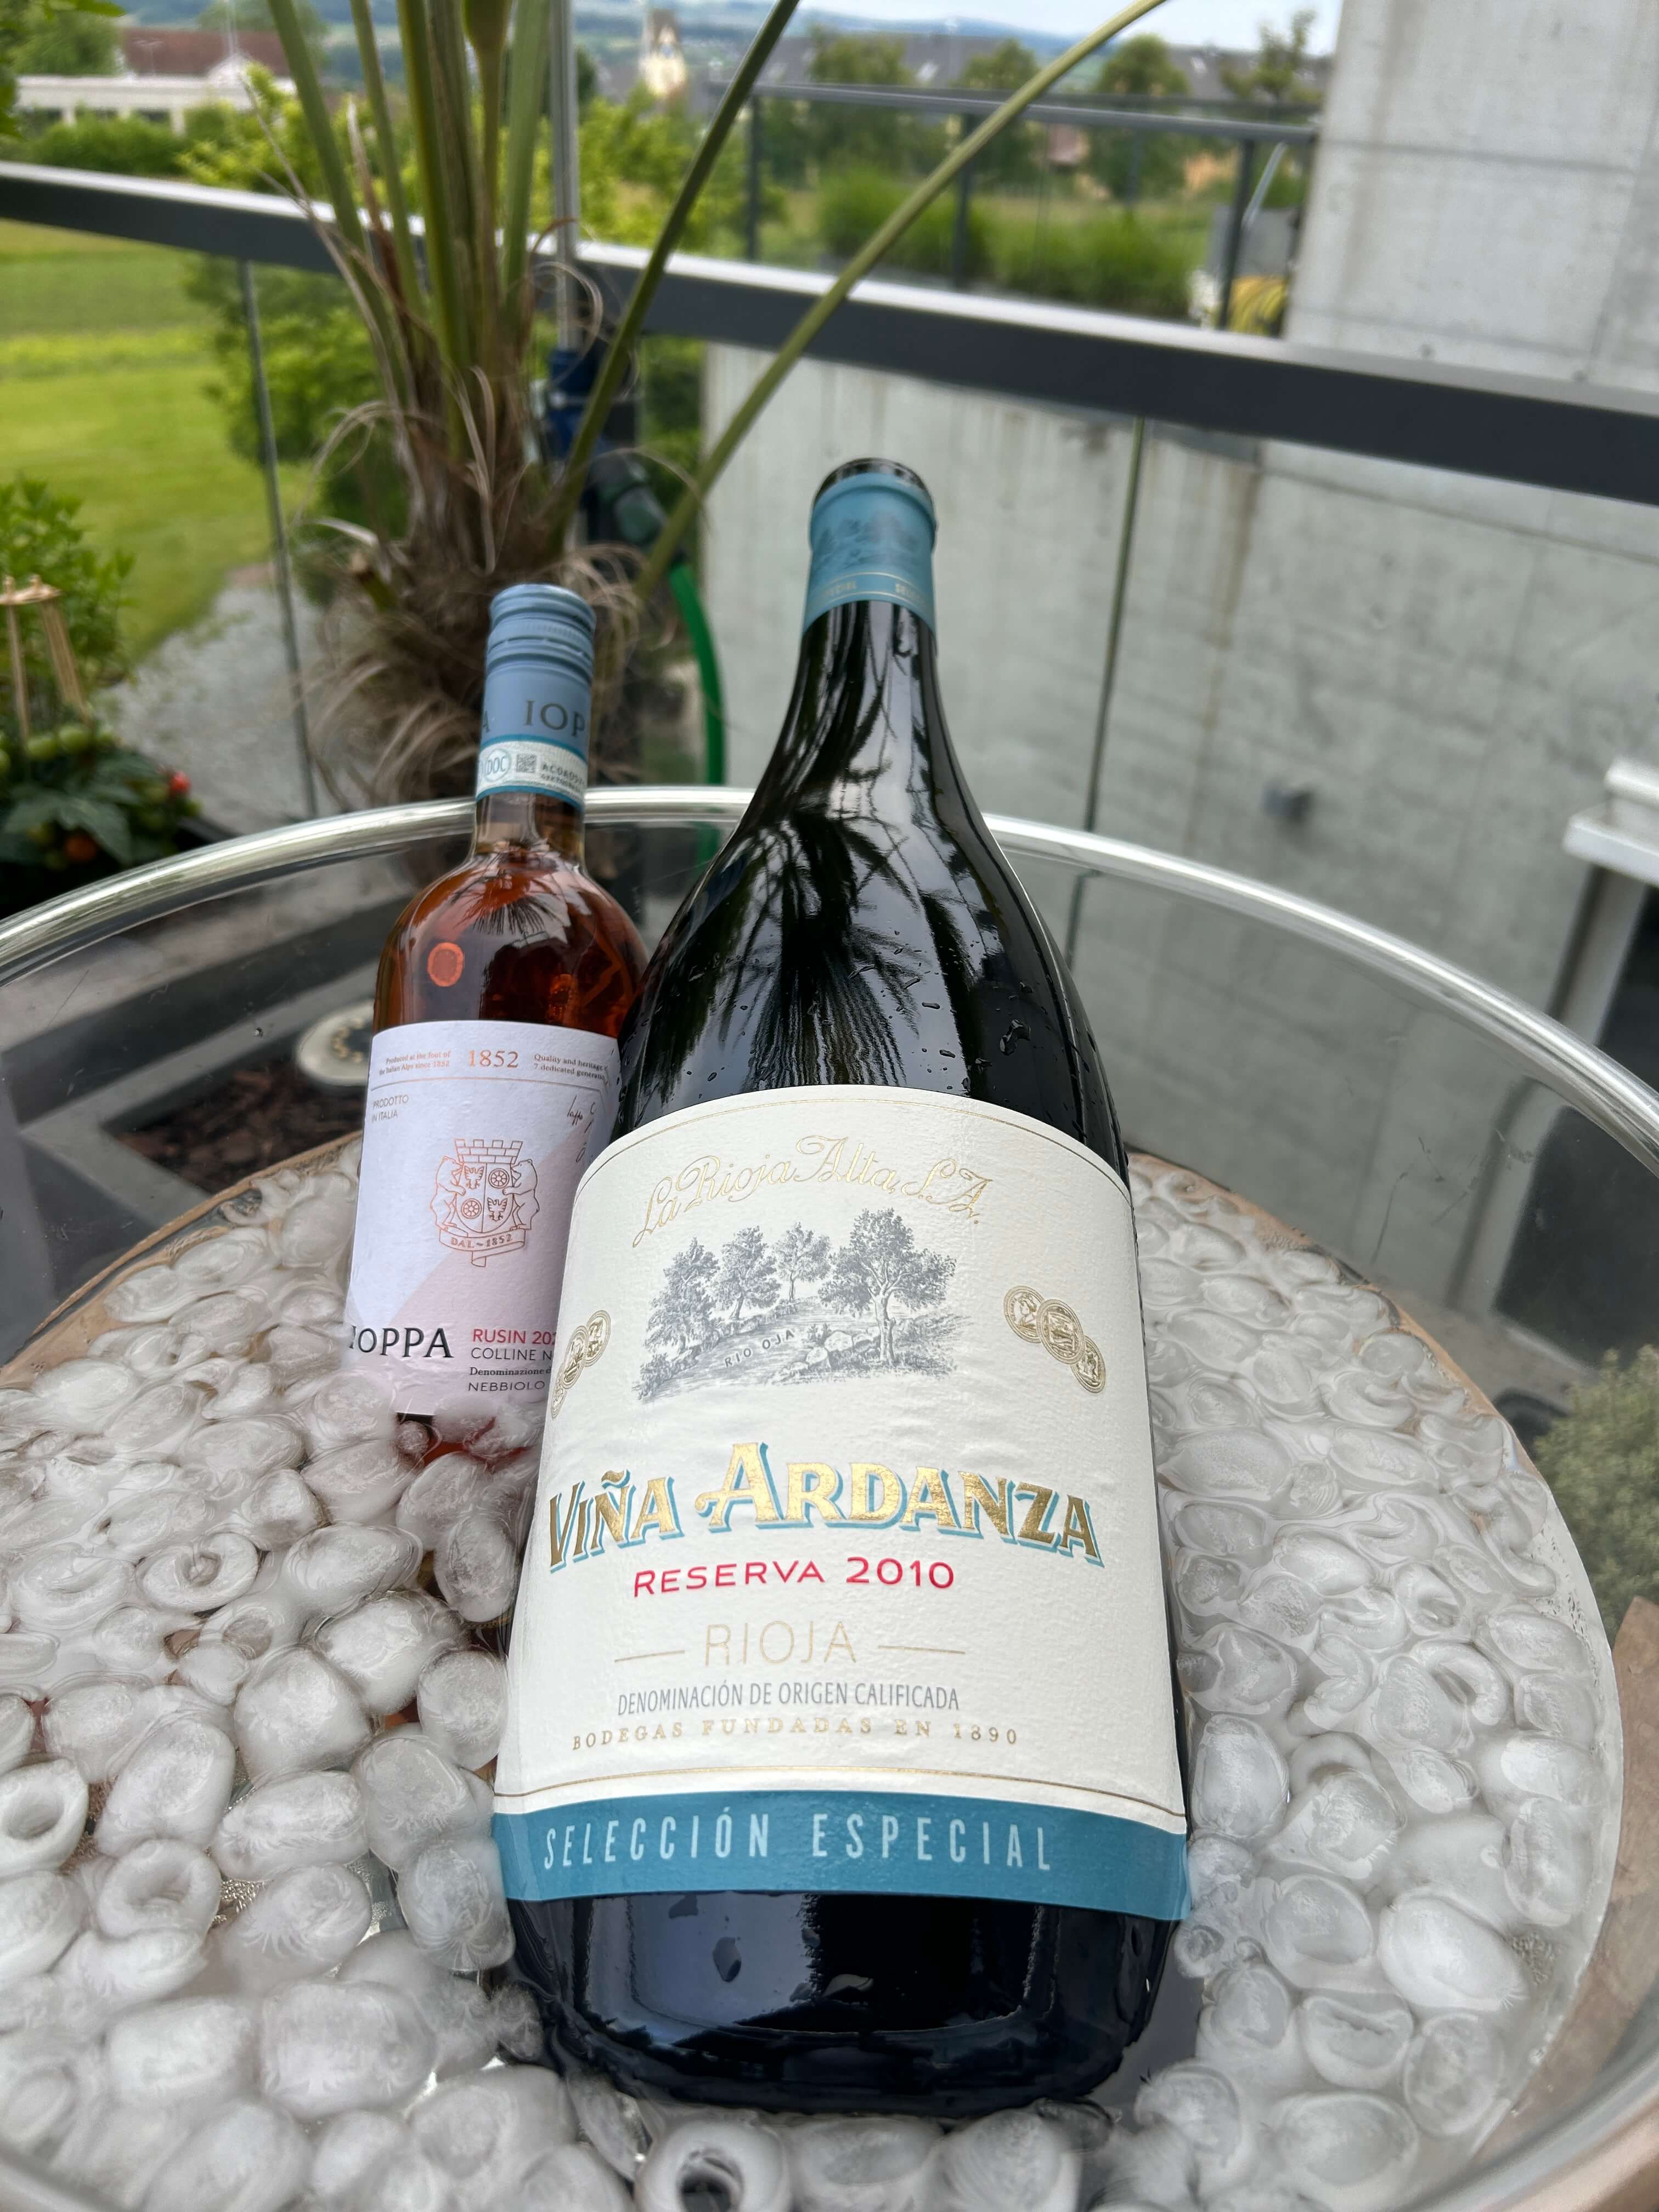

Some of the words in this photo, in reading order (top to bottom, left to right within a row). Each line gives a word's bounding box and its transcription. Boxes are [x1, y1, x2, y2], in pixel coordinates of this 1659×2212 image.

[487, 756, 507, 776] DOC
[386, 1054, 408, 1064] Produced
[443, 1049, 452, 1058] of
[468, 1049, 519, 1069] 1852
[534, 1053, 561, 1064] Quality
[578, 1059, 603, 1071] heritage
[386, 1065, 400, 1074] Italian
[540, 1063, 575, 1075] dedicated
[373, 1094, 409, 1110] PRODOTTO
[372, 1114, 377, 1123] IN
[379, 1110, 398, 1121] ITALIA
[632, 1176, 681, 1248] La
[675, 1155, 794, 1213] Rioja
[450, 1236, 475, 1249] DAL
[486, 1234, 514, 1248] 1852
[472, 1328, 527, 1344] RUSIN
[471, 1347, 536, 1361] COLLINE
[724, 1347, 752, 1368] RIO
[762, 1329, 795, 1350] OJA
[469, 1366, 545, 1376] Denominazione
[468, 1380, 545, 1392] NEBBIOLO
[633, 1560, 825, 1598] RESERVA
[845, 1556, 955, 1589] 2010
[704, 1621, 857, 1667] RIOJA
[617, 1679, 743, 1716] DENOMINACIÓN
[749, 1681, 772, 1706] DE
[778, 1681, 848, 1706] ORIGEN
[854, 1683, 960, 1711] CALIFICADA
[572, 1720, 684, 1751] BODEGAS
[702, 1717, 872, 1736] FUNDADAS
[895, 1719, 931, 1738] EN
[953, 1721, 1018, 1746] 1890
[544, 1807, 769, 1870] SELECCIÓN
[812, 1813, 1051, 1871] ESPECIAL
